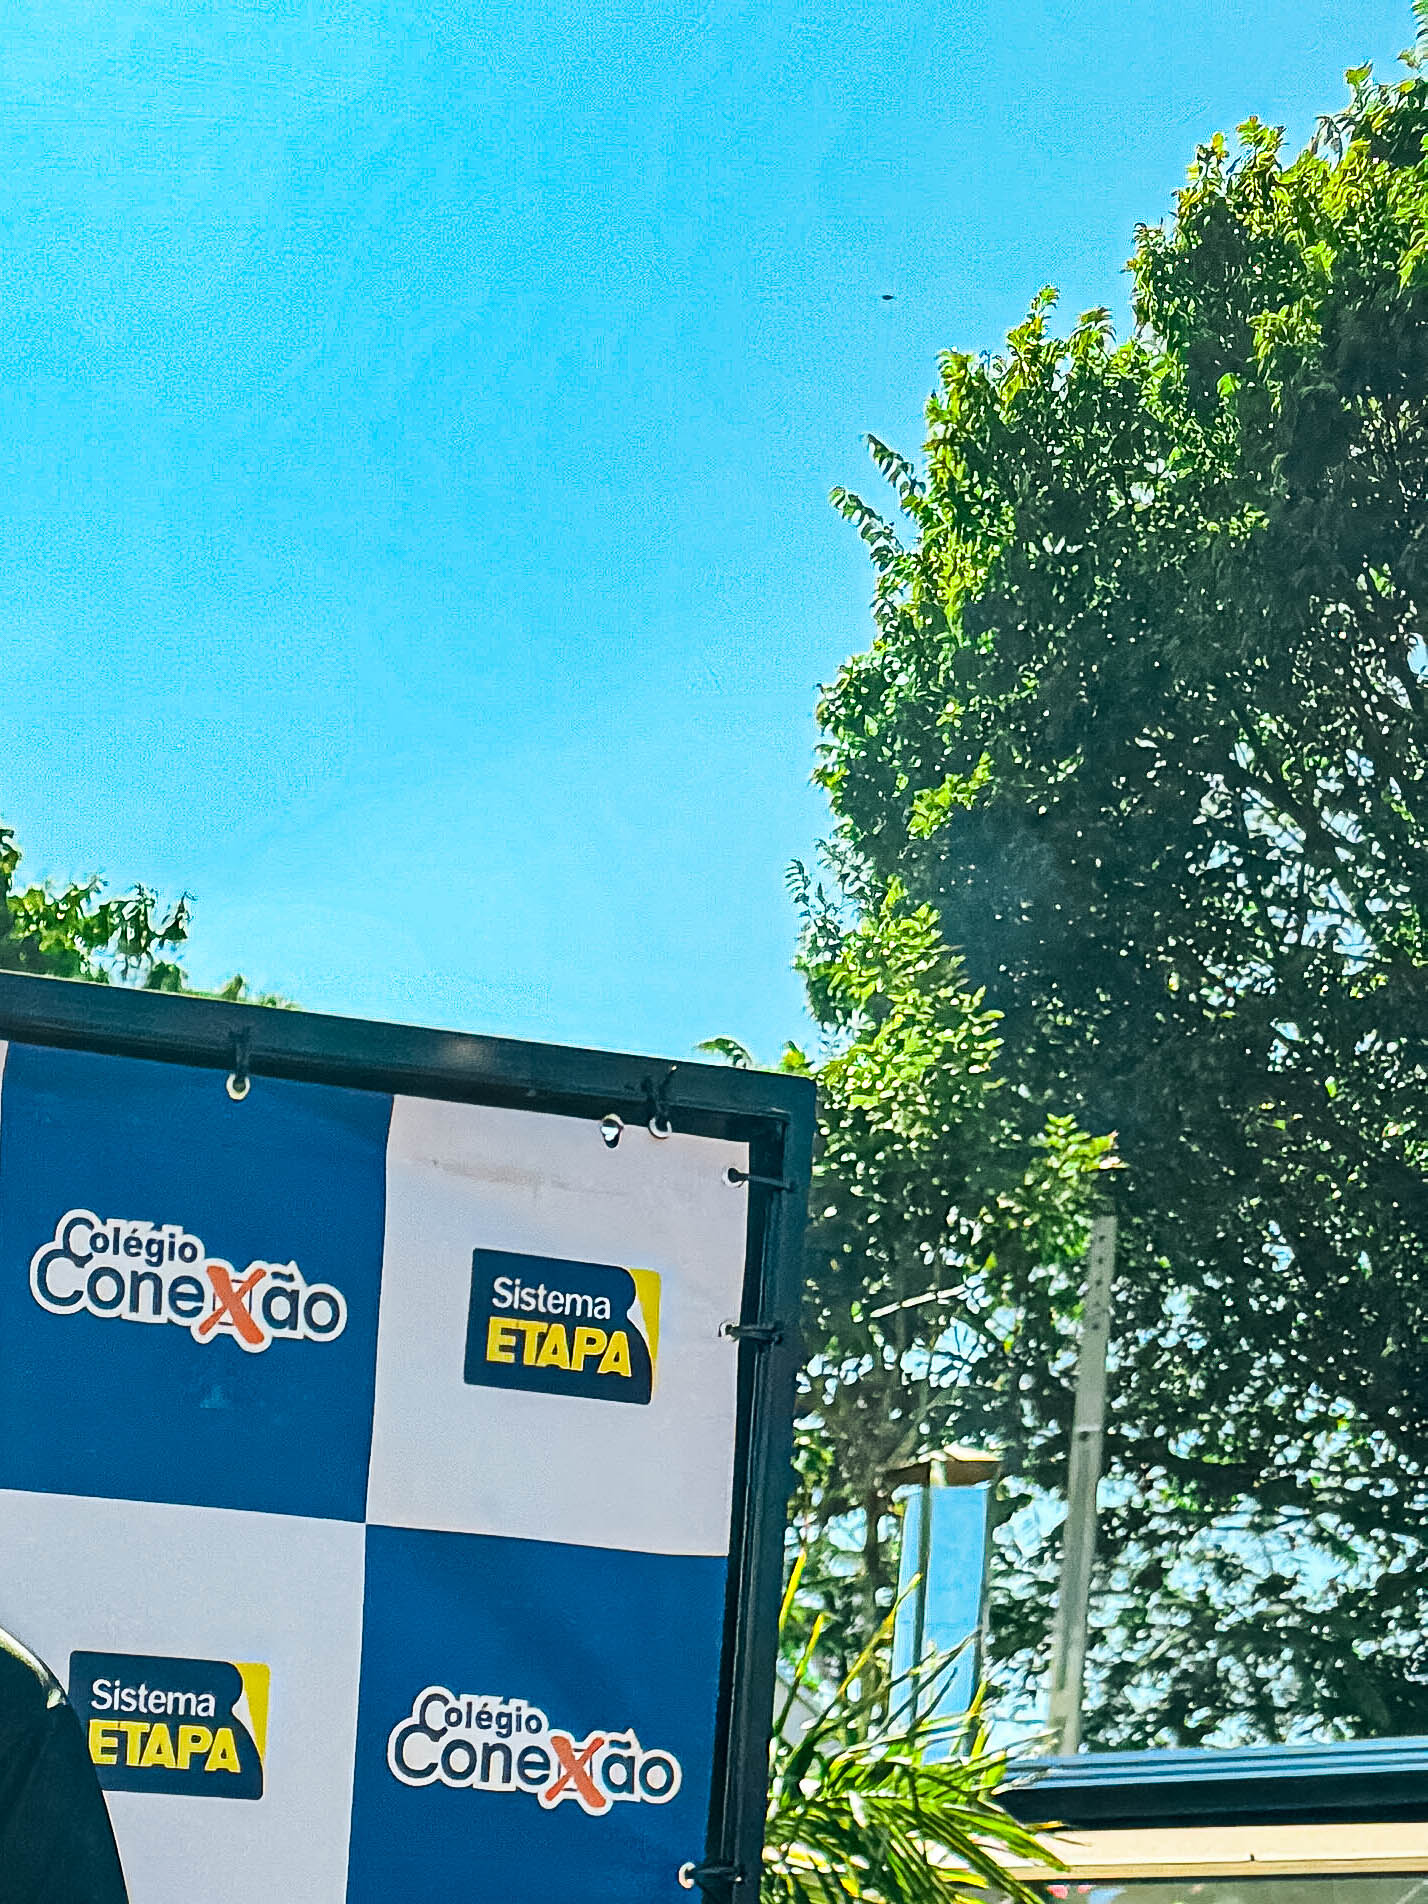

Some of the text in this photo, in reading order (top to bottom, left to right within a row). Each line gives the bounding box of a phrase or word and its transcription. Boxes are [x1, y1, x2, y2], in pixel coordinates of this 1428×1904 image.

[65, 1218, 198, 1264] Colégio
[493, 1278, 612, 1318] Sistema
[486, 1319, 631, 1378] ETAPA
[91, 1679, 216, 1716] Sistema
[419, 1694, 542, 1738] Colégio
[88, 1719, 240, 1774] ETAPA
